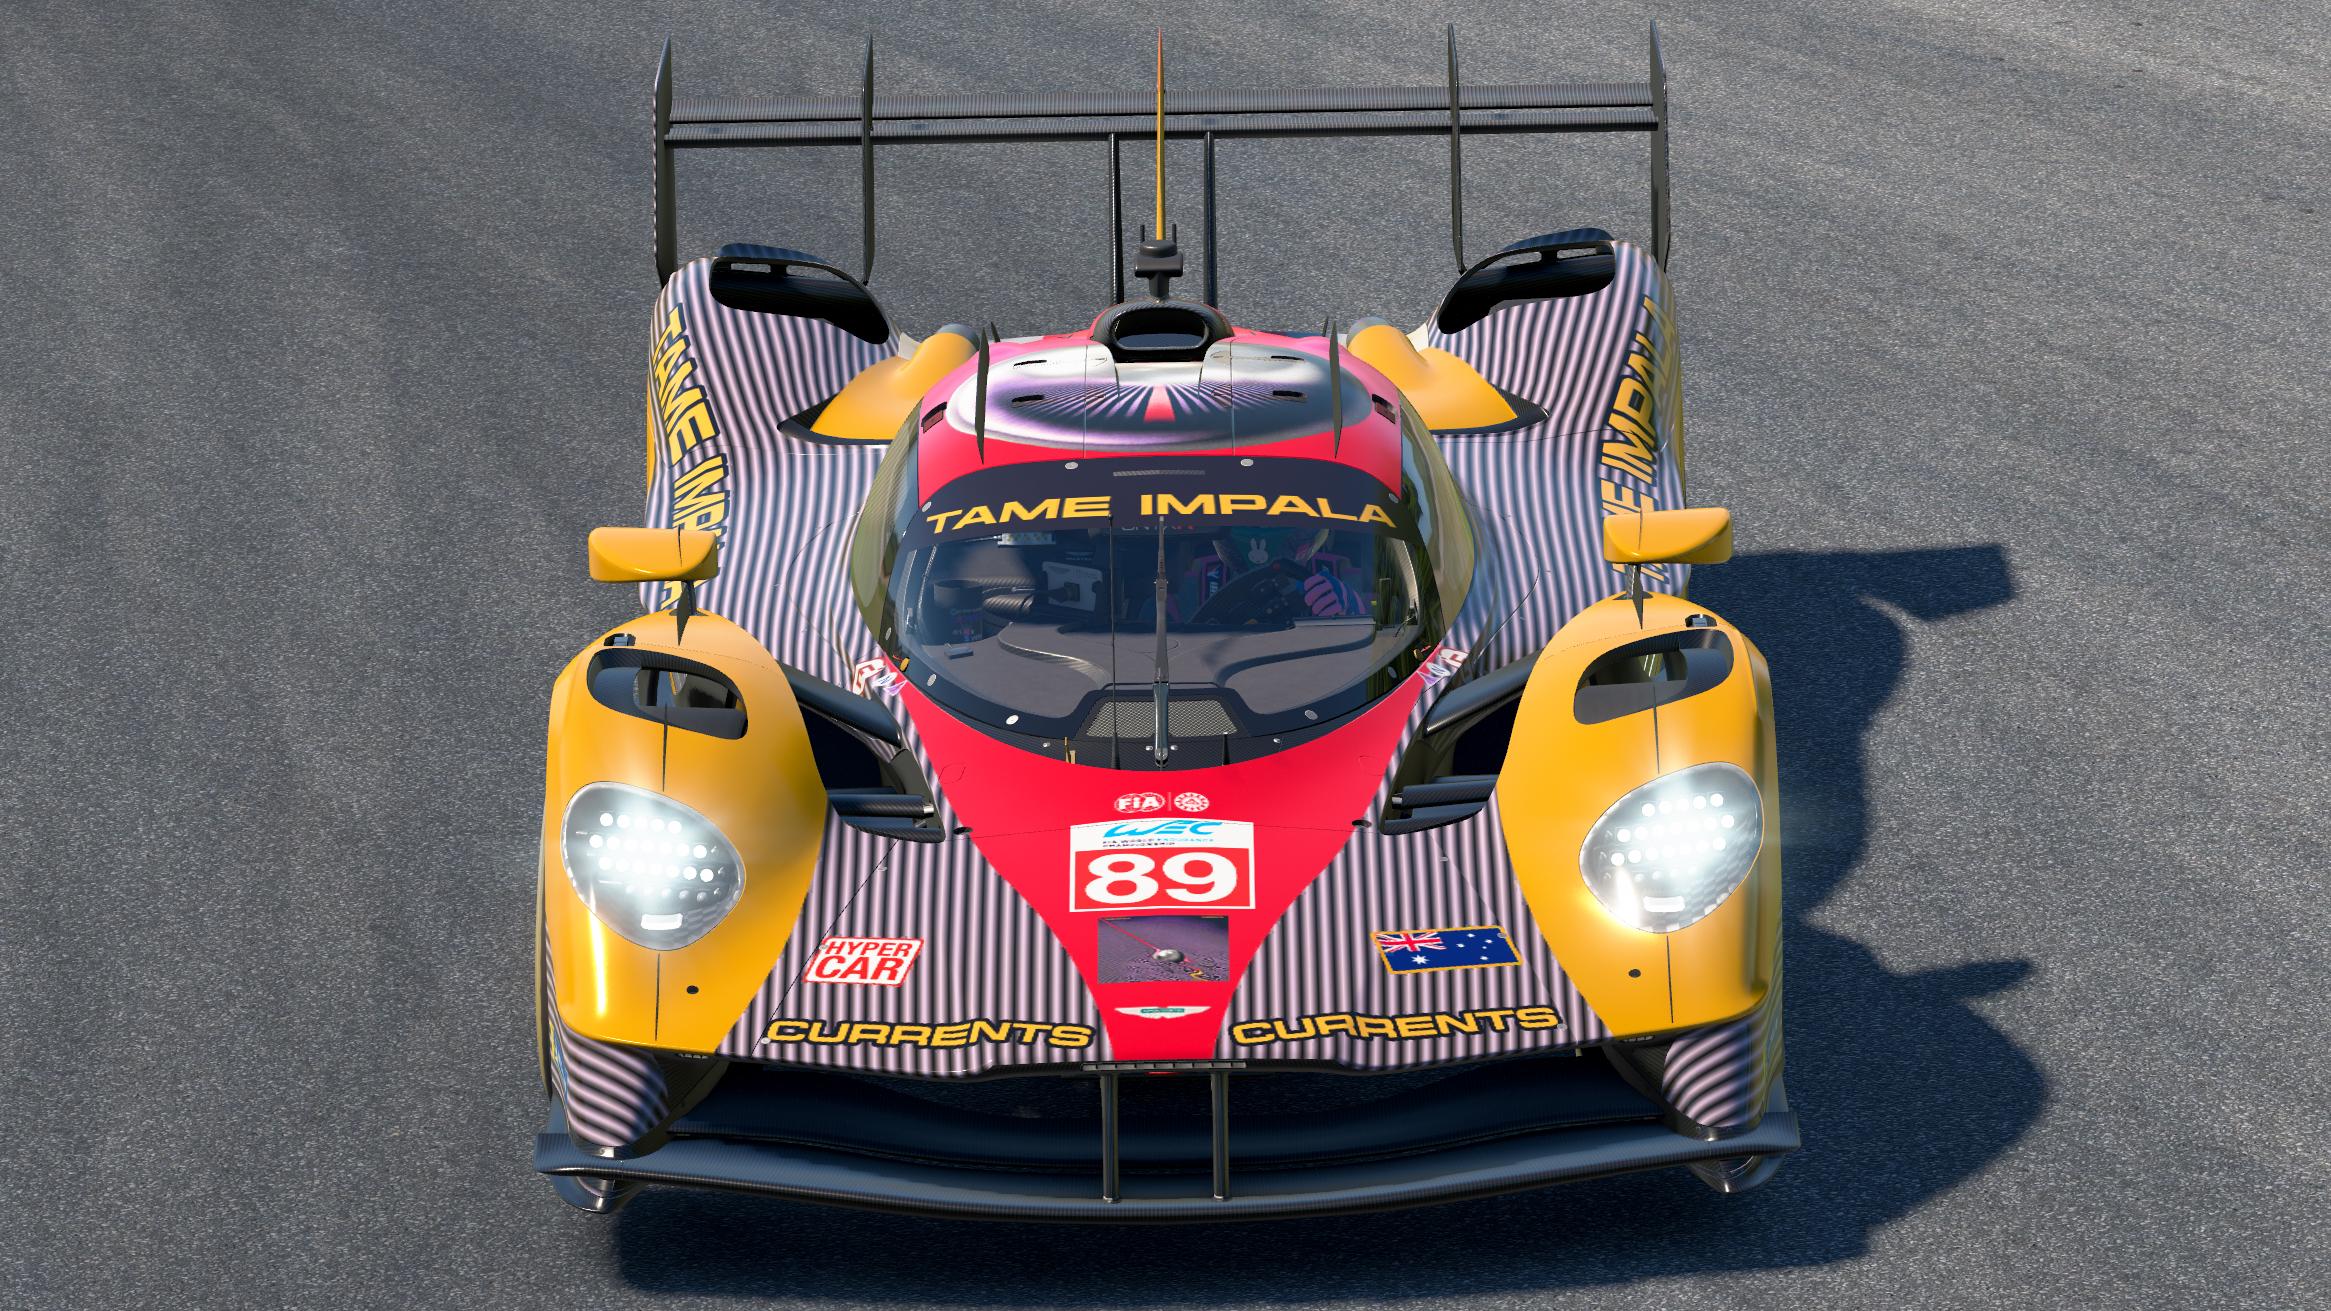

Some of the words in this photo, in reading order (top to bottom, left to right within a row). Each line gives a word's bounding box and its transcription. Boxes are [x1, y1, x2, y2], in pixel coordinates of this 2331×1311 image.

[651, 302, 720, 468] TAME
[926, 496, 1112, 534] TAME
[1140, 494, 1397, 528] IMPALA
[1118, 796, 1160, 810] FIA
[1103, 819, 1223, 838] WEC
[1084, 852, 1238, 904] 89
[827, 941, 914, 957] HYPER
[815, 957, 905, 981] CAR
[766, 1020, 1095, 1048] CURRENTS
[1231, 1006, 1559, 1045] CURRENTS
